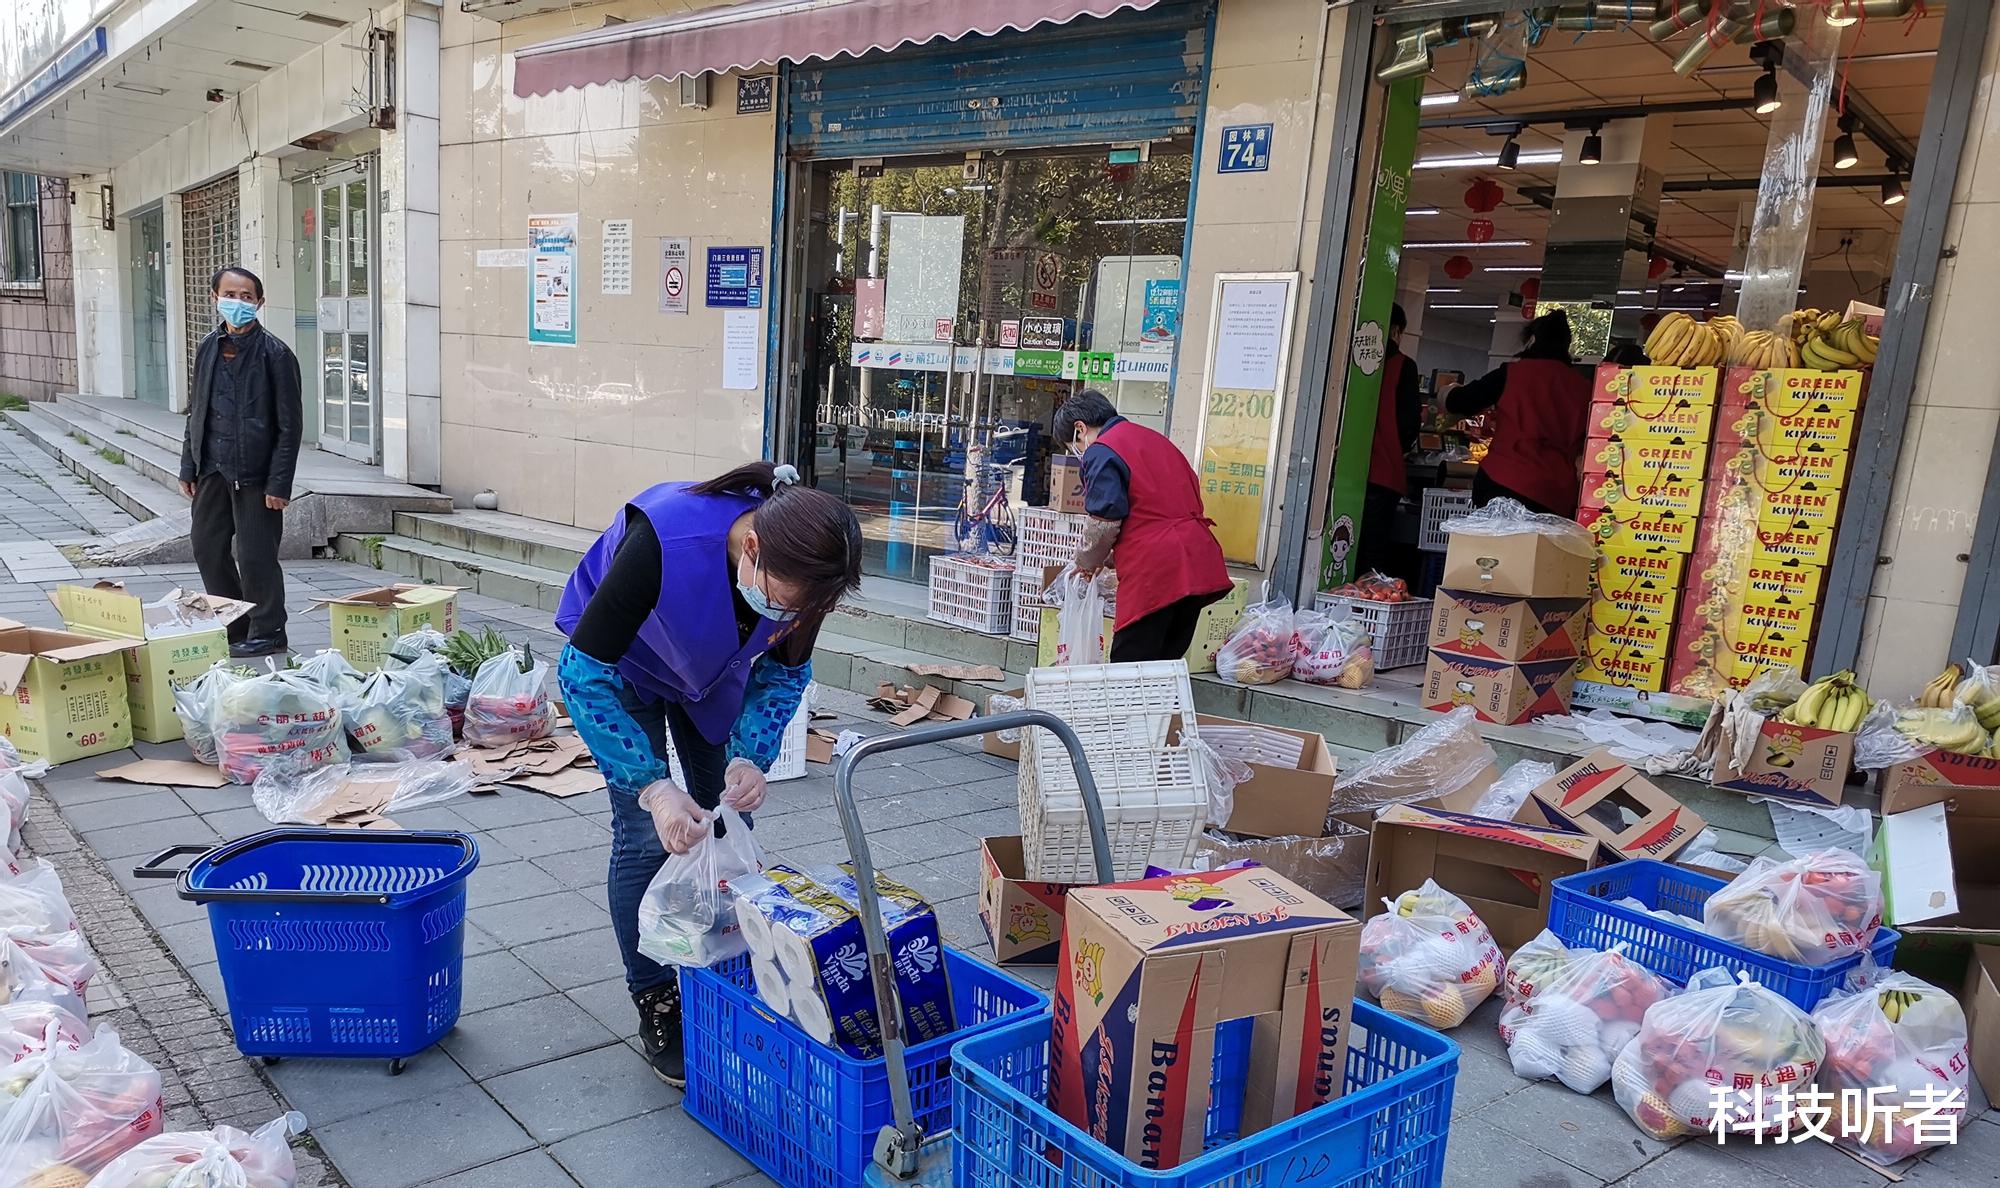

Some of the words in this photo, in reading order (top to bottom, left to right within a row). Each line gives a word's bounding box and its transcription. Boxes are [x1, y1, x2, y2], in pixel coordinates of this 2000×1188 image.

[1229, 129, 1265, 142] 园林路
[1227, 143, 1255, 167] 74
[1024, 322, 1061, 335] 小心玻璃
[1023, 337, 1043, 346] Caution
[1045, 337, 1060, 347] Glass
[916, 353, 935, 365] 丽红
[1128, 361, 1169, 373] LIHONG
[1650, 375, 1704, 386] GREEN
[1787, 378, 1848, 389] GREEN
[1654, 388, 1684, 396] KIWI
[1792, 391, 1825, 400] KIWI
[1209, 391, 1275, 418] 22:00
[1644, 413, 1698, 423] GREEN
[1780, 417, 1840, 429] GREEN
[1649, 425, 1678, 434] KIWI
[1785, 430, 1817, 439] KIWI
[1639, 448, 1693, 459] GREEN
[1643, 461, 1672, 469] KIWI
[1774, 455, 1834, 468] GREEN
[1204, 460, 1266, 478] 周一至周日
[1779, 468, 1811, 478] KIWI
[1206, 479, 1260, 497] 全年无休
[1636, 485, 1690, 497] GREEN
[1641, 498, 1670, 506] KIWI
[1767, 493, 1827, 506] GREEN
[1772, 506, 1804, 516] KIWI
[1630, 521, 1683, 533] GREEN
[1635, 533, 1664, 542] KIWI
[1760, 531, 1819, 545] GREEN
[1764, 545, 1796, 554] KIWI
[1616, 556, 1669, 569] GREEN
[1621, 568, 1649, 578] KIWI
[1749, 568, 1807, 583] GREEN
[1753, 581, 1785, 592] KIWI
[1612, 590, 1664, 604] GREEN
[1616, 602, 1644, 612] KIWI
[1743, 604, 1801, 620] GREEN
[1747, 618, 1778, 628] KIWI
[1606, 624, 1657, 640] GREEN
[1610, 637, 1637, 647] KIWI
[1735, 641, 1793, 658] GREEN
[1600, 657, 1651, 673] GREEN
[1739, 654, 1771, 665] KIWI
[1605, 670, 1632, 680] KIWI
[1728, 676, 1751, 688] GR
[276, 707, 336, 724] 丽红超市
[81, 732, 97, 747] 60
[1937, 751, 1997, 770] anas
[1557, 762, 1602, 792] Bananas
[1641, 823, 1686, 856] Bananas
[898, 944, 921, 984] Vinda
[824, 953, 850, 994] Vinda
[1733, 1059, 1818, 1090] 丽红超市
[1142, 1038, 1179, 1169] Banan
[1279, 1153, 1331, 1188] 120
